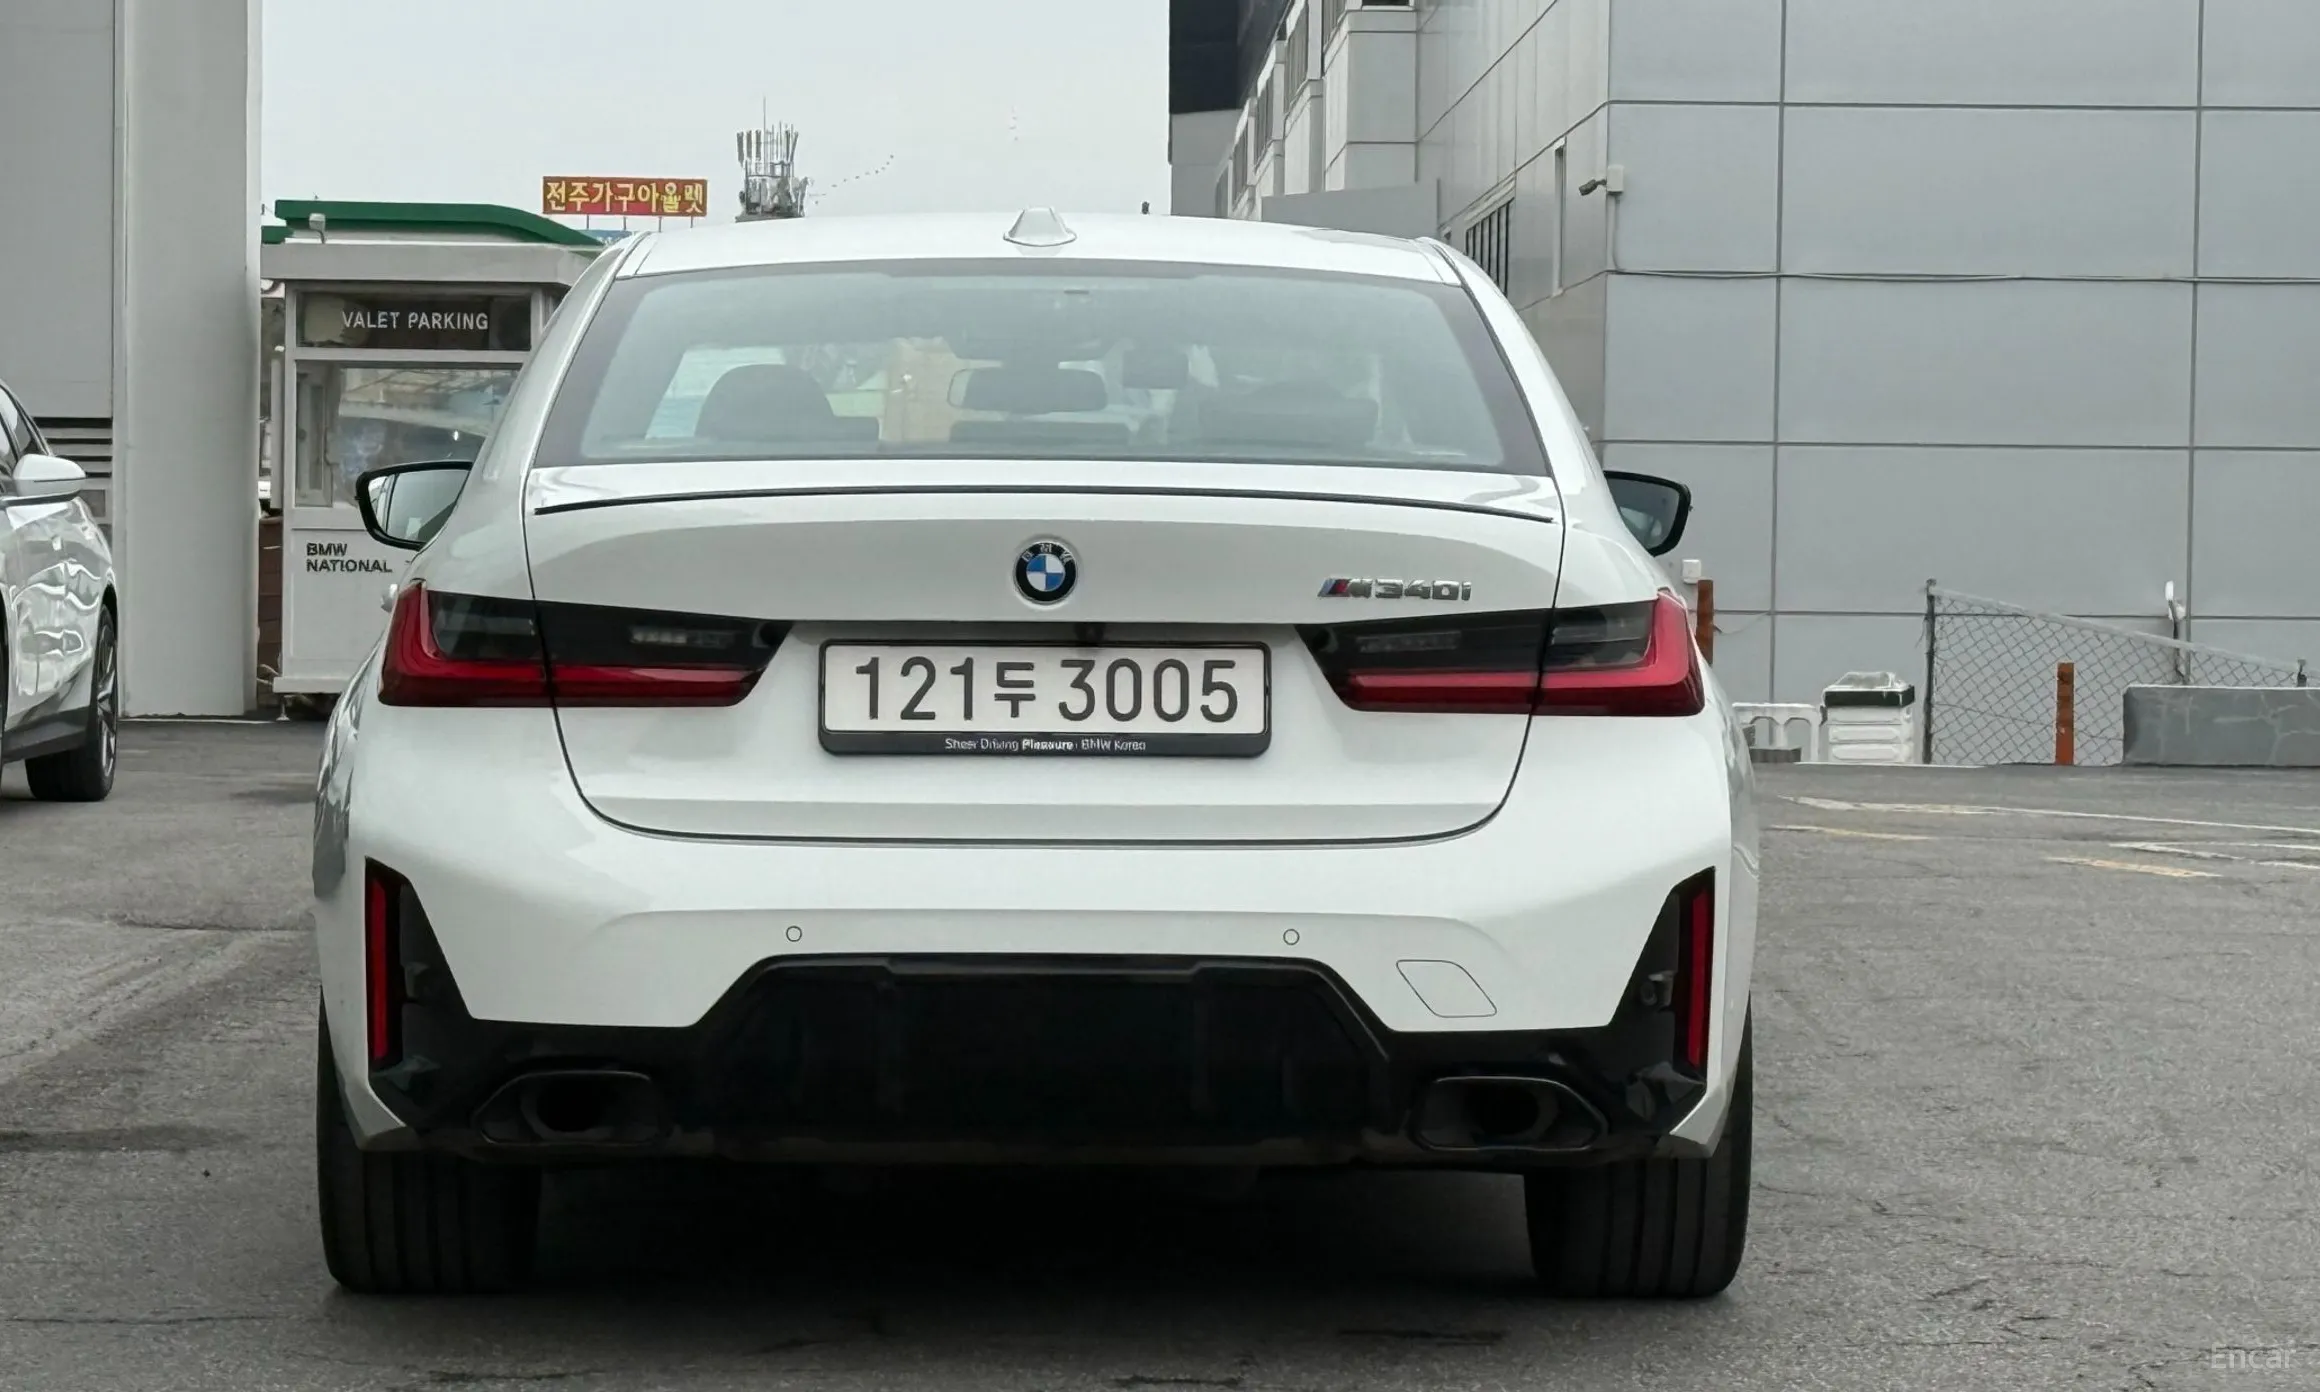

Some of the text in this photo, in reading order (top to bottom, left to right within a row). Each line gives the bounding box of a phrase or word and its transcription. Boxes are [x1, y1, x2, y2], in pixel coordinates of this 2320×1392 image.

[342, 310, 489, 330] VALET PARKING
[306, 542, 348, 556] BMW
[306, 559, 393, 573] NATIONAL
[855, 656, 1239, 723] 121두 3005
